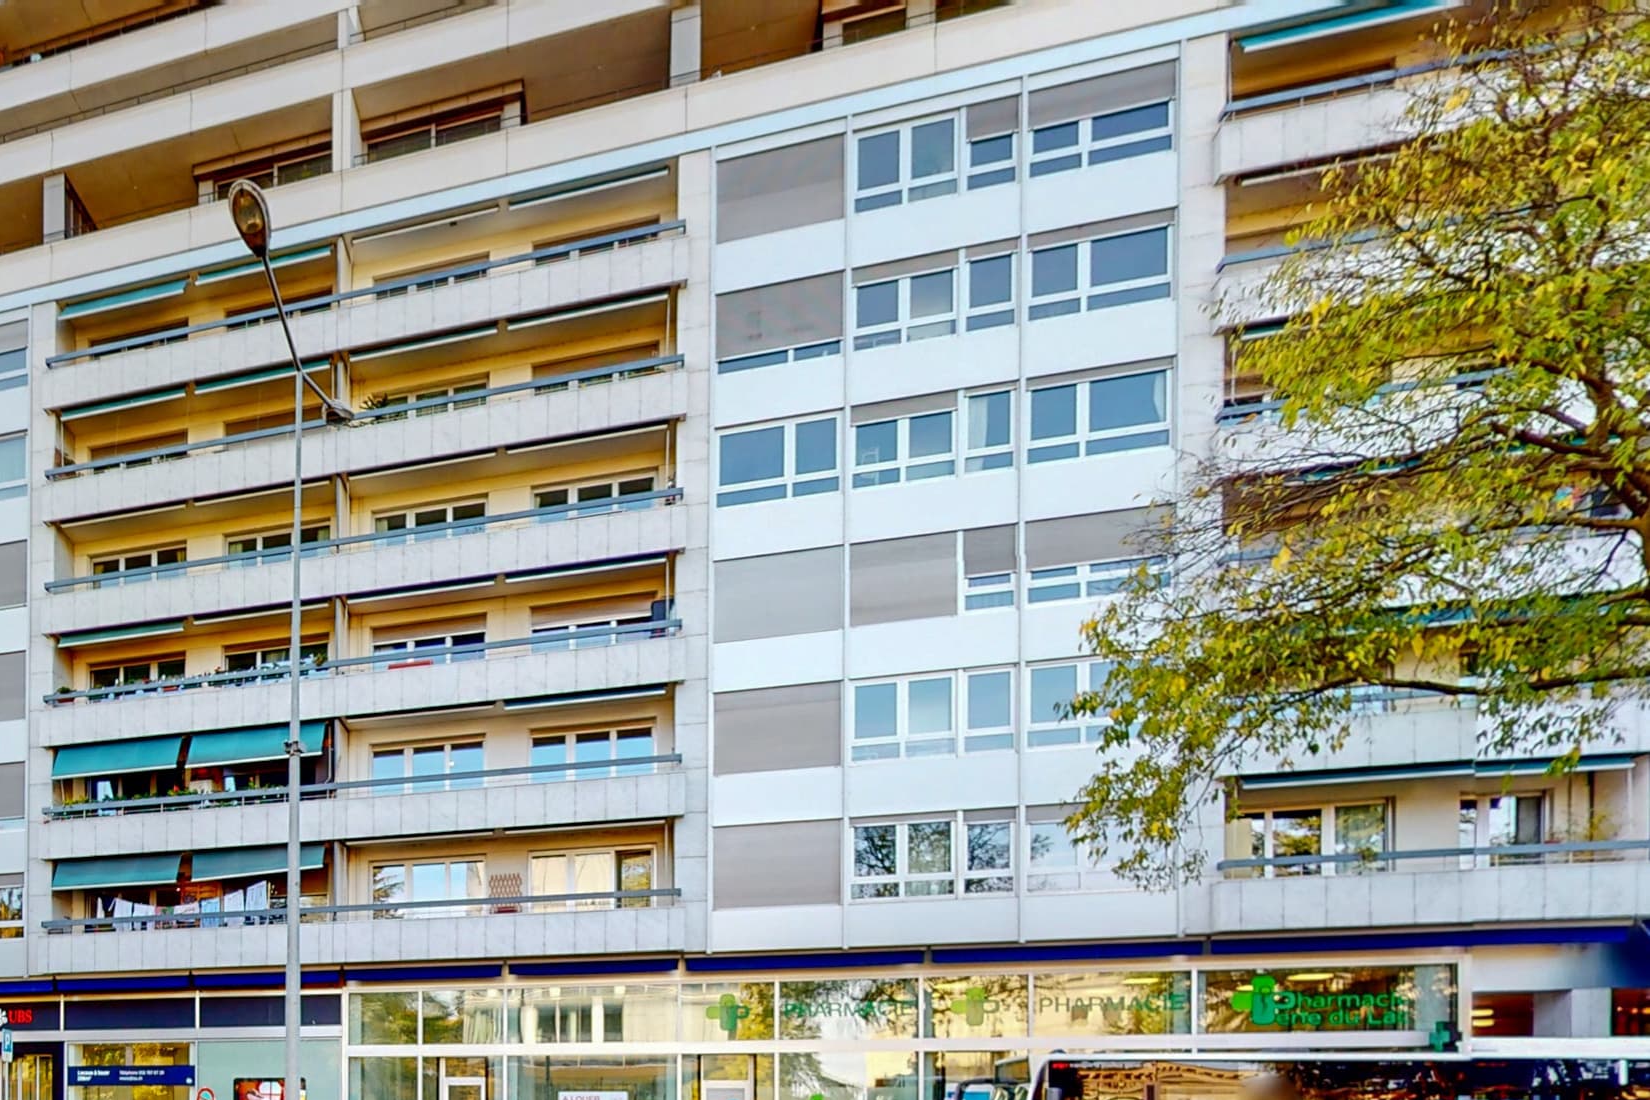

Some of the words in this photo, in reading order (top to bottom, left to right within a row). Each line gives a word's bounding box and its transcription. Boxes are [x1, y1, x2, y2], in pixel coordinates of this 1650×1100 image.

[784, 1000, 917, 1018] PHARMACIE
[1038, 994, 1188, 1013] PHARMACIE
[8, 1009, 33, 1024] UBS
